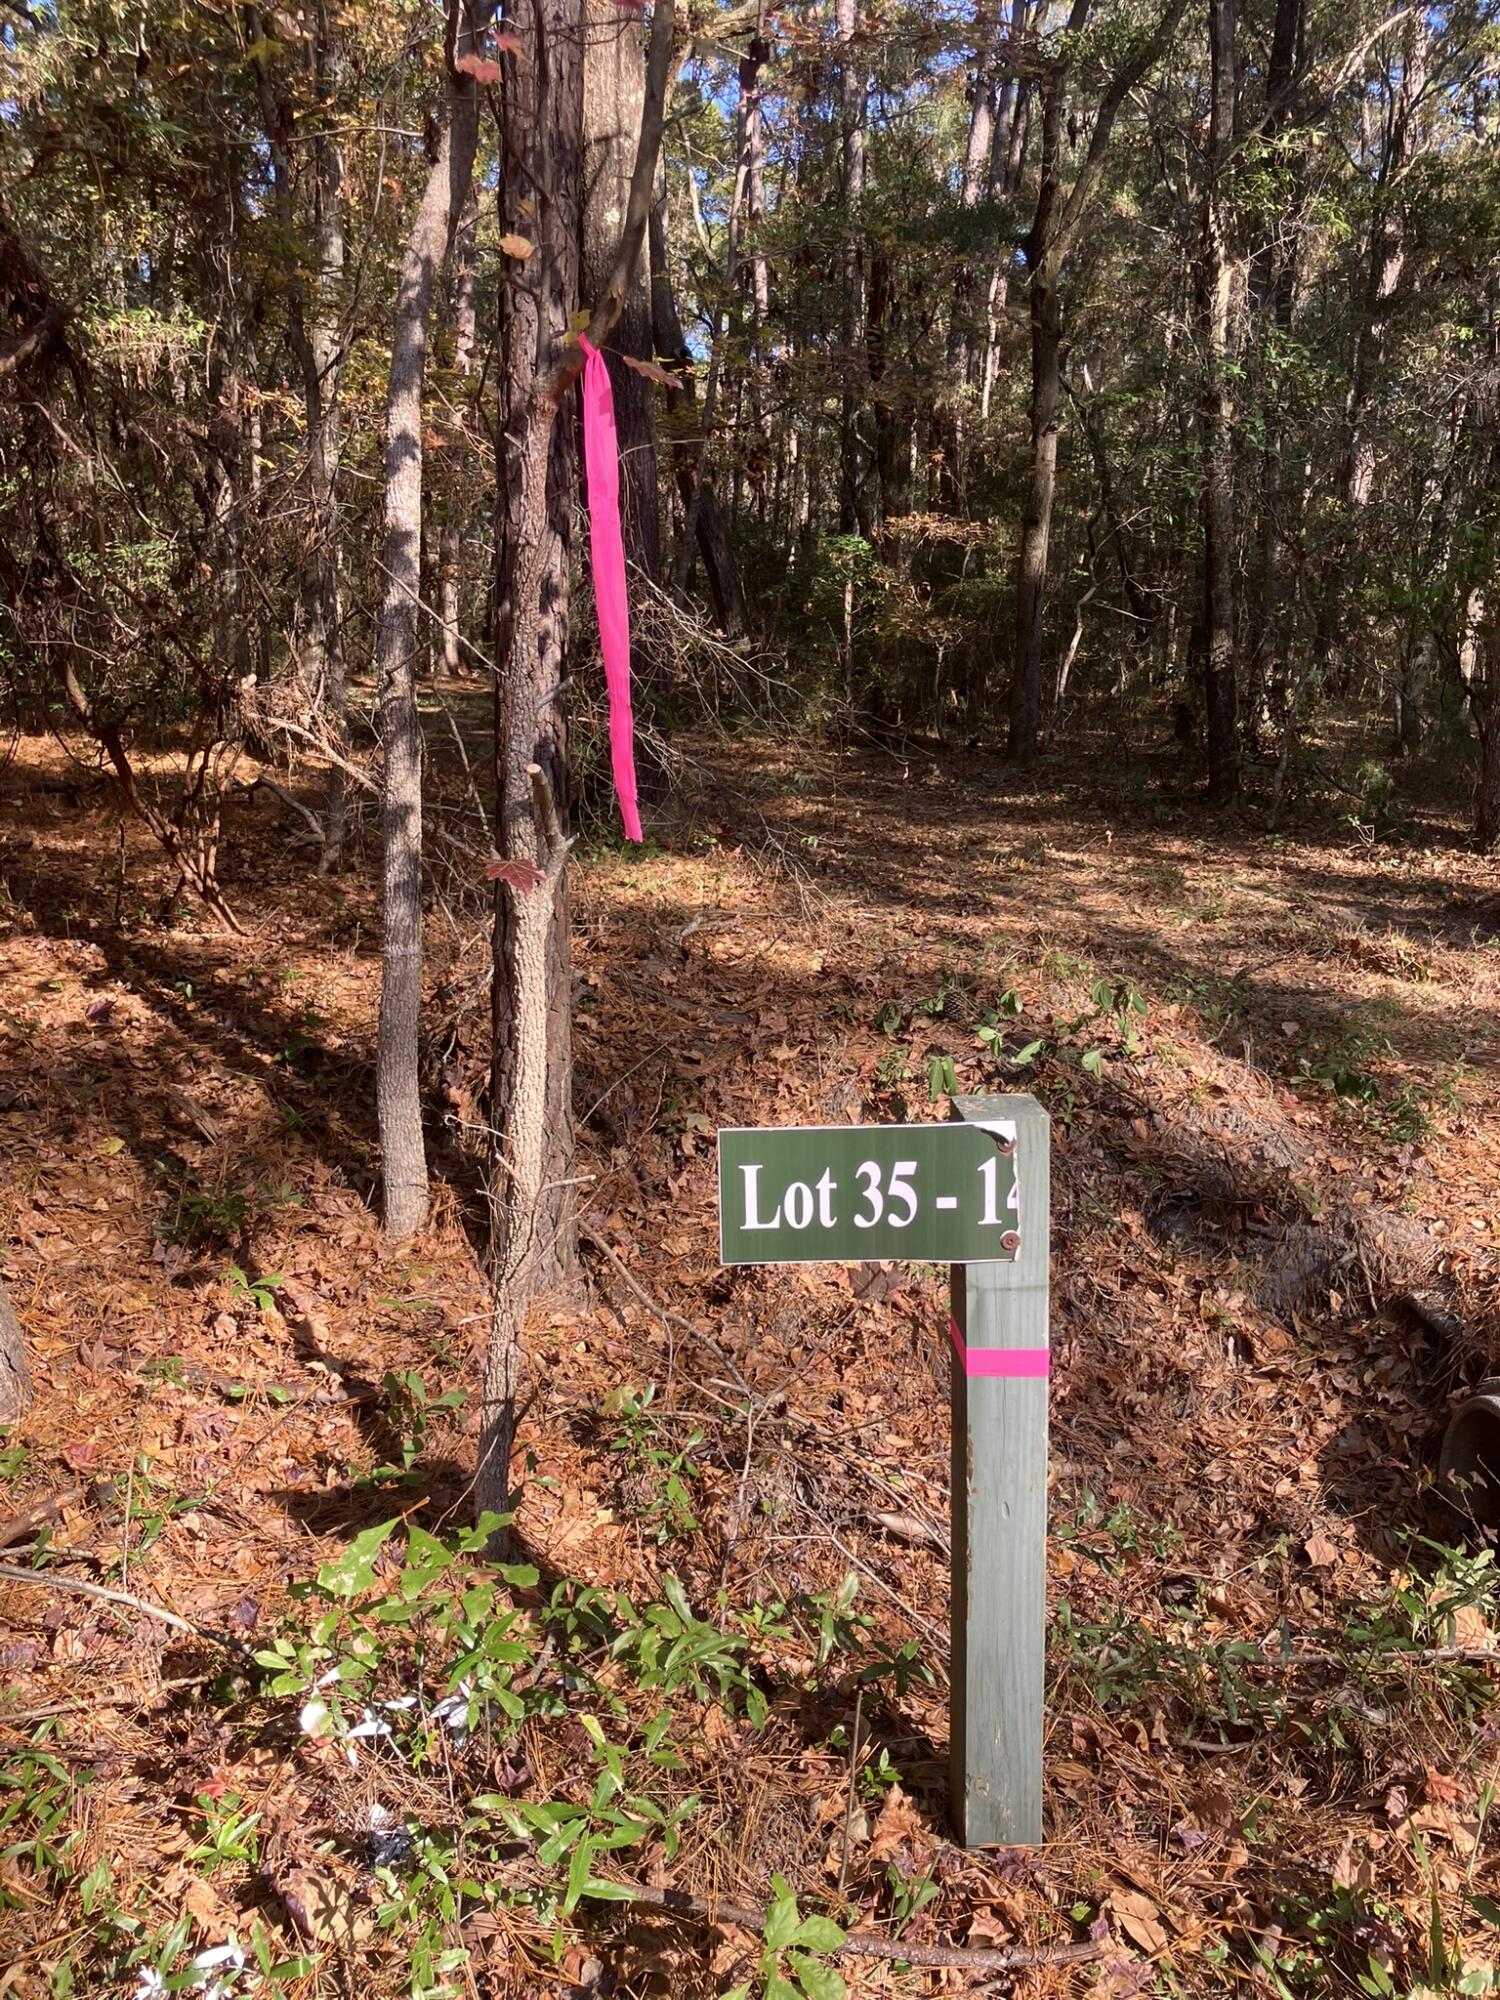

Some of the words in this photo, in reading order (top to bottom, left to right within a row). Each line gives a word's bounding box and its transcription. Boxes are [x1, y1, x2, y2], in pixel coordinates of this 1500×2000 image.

[738, 1164, 837, 1230] Lot
[853, 1160, 918, 1228] 35
[936, 1196, 957, 1209] -
